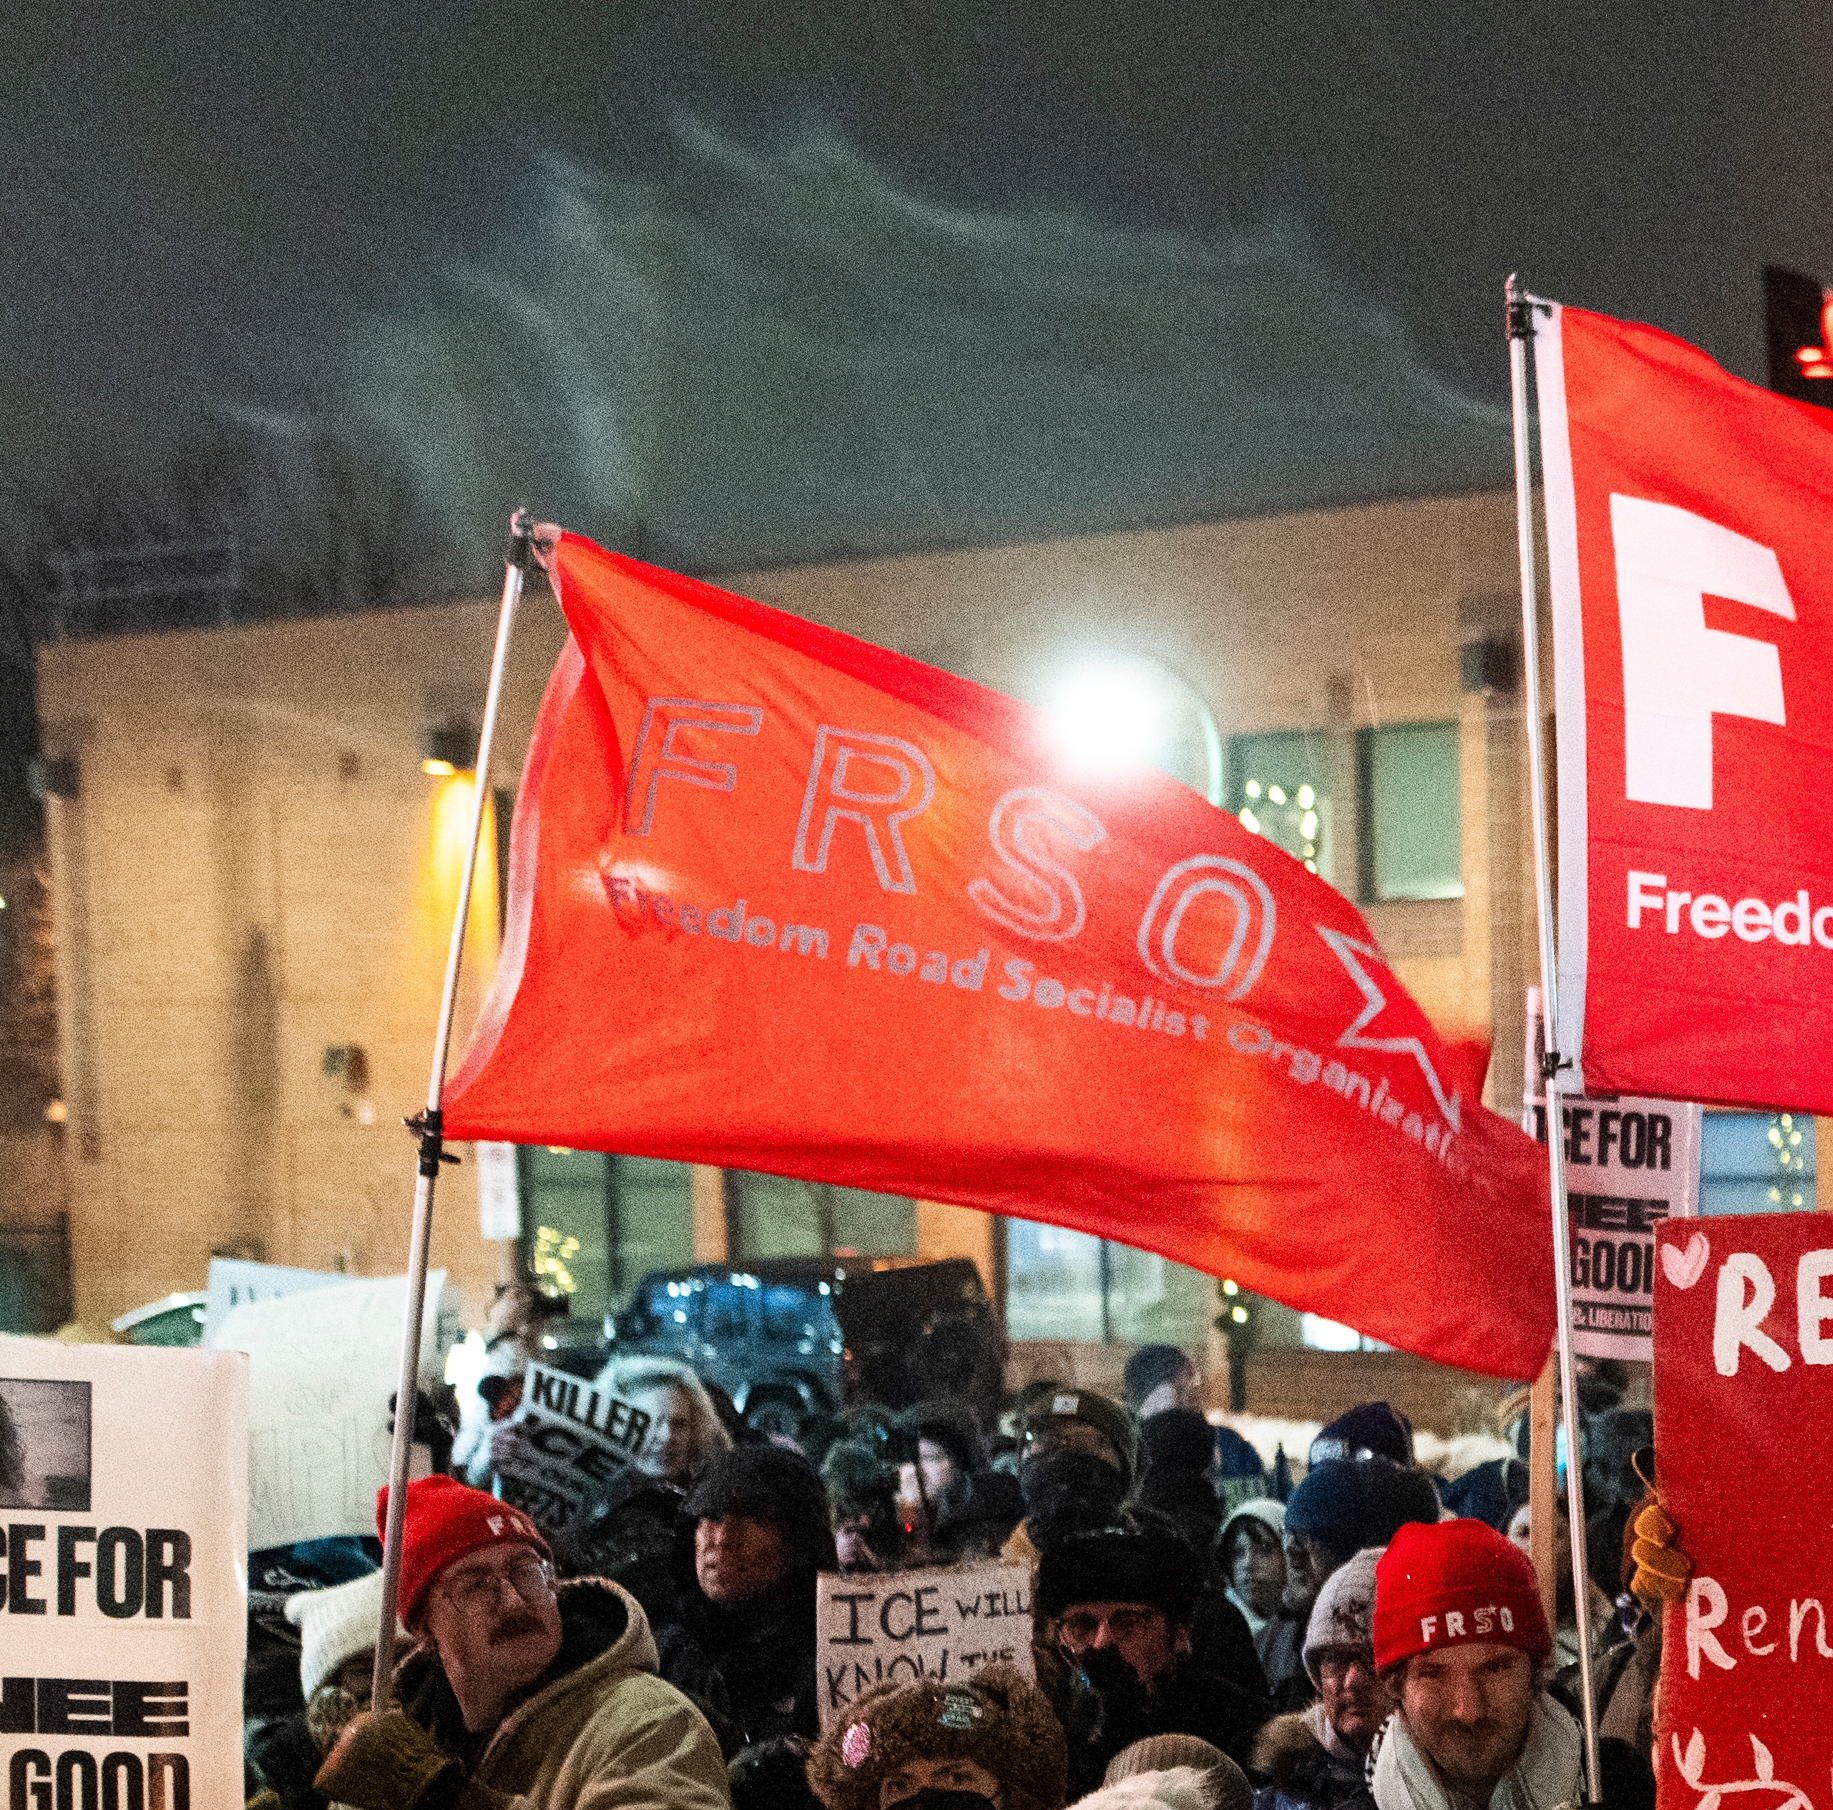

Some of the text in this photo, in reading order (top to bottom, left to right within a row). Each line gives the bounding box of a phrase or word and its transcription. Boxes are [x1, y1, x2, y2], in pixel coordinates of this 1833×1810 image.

[624, 696, 1277, 1003] FRSO
[847, 921, 992, 994] Road
[996, 954, 1212, 1042] Socialist
[1597, 1110, 1672, 1171] FOR
[1588, 1309, 1653, 1336] LIBERATIO
[531, 1367, 652, 1456] KILLER
[56, 1524, 193, 1620] FOR
[828, 1585, 1034, 1647] ICE WILL
[1419, 1603, 1515, 1644] FRSO
